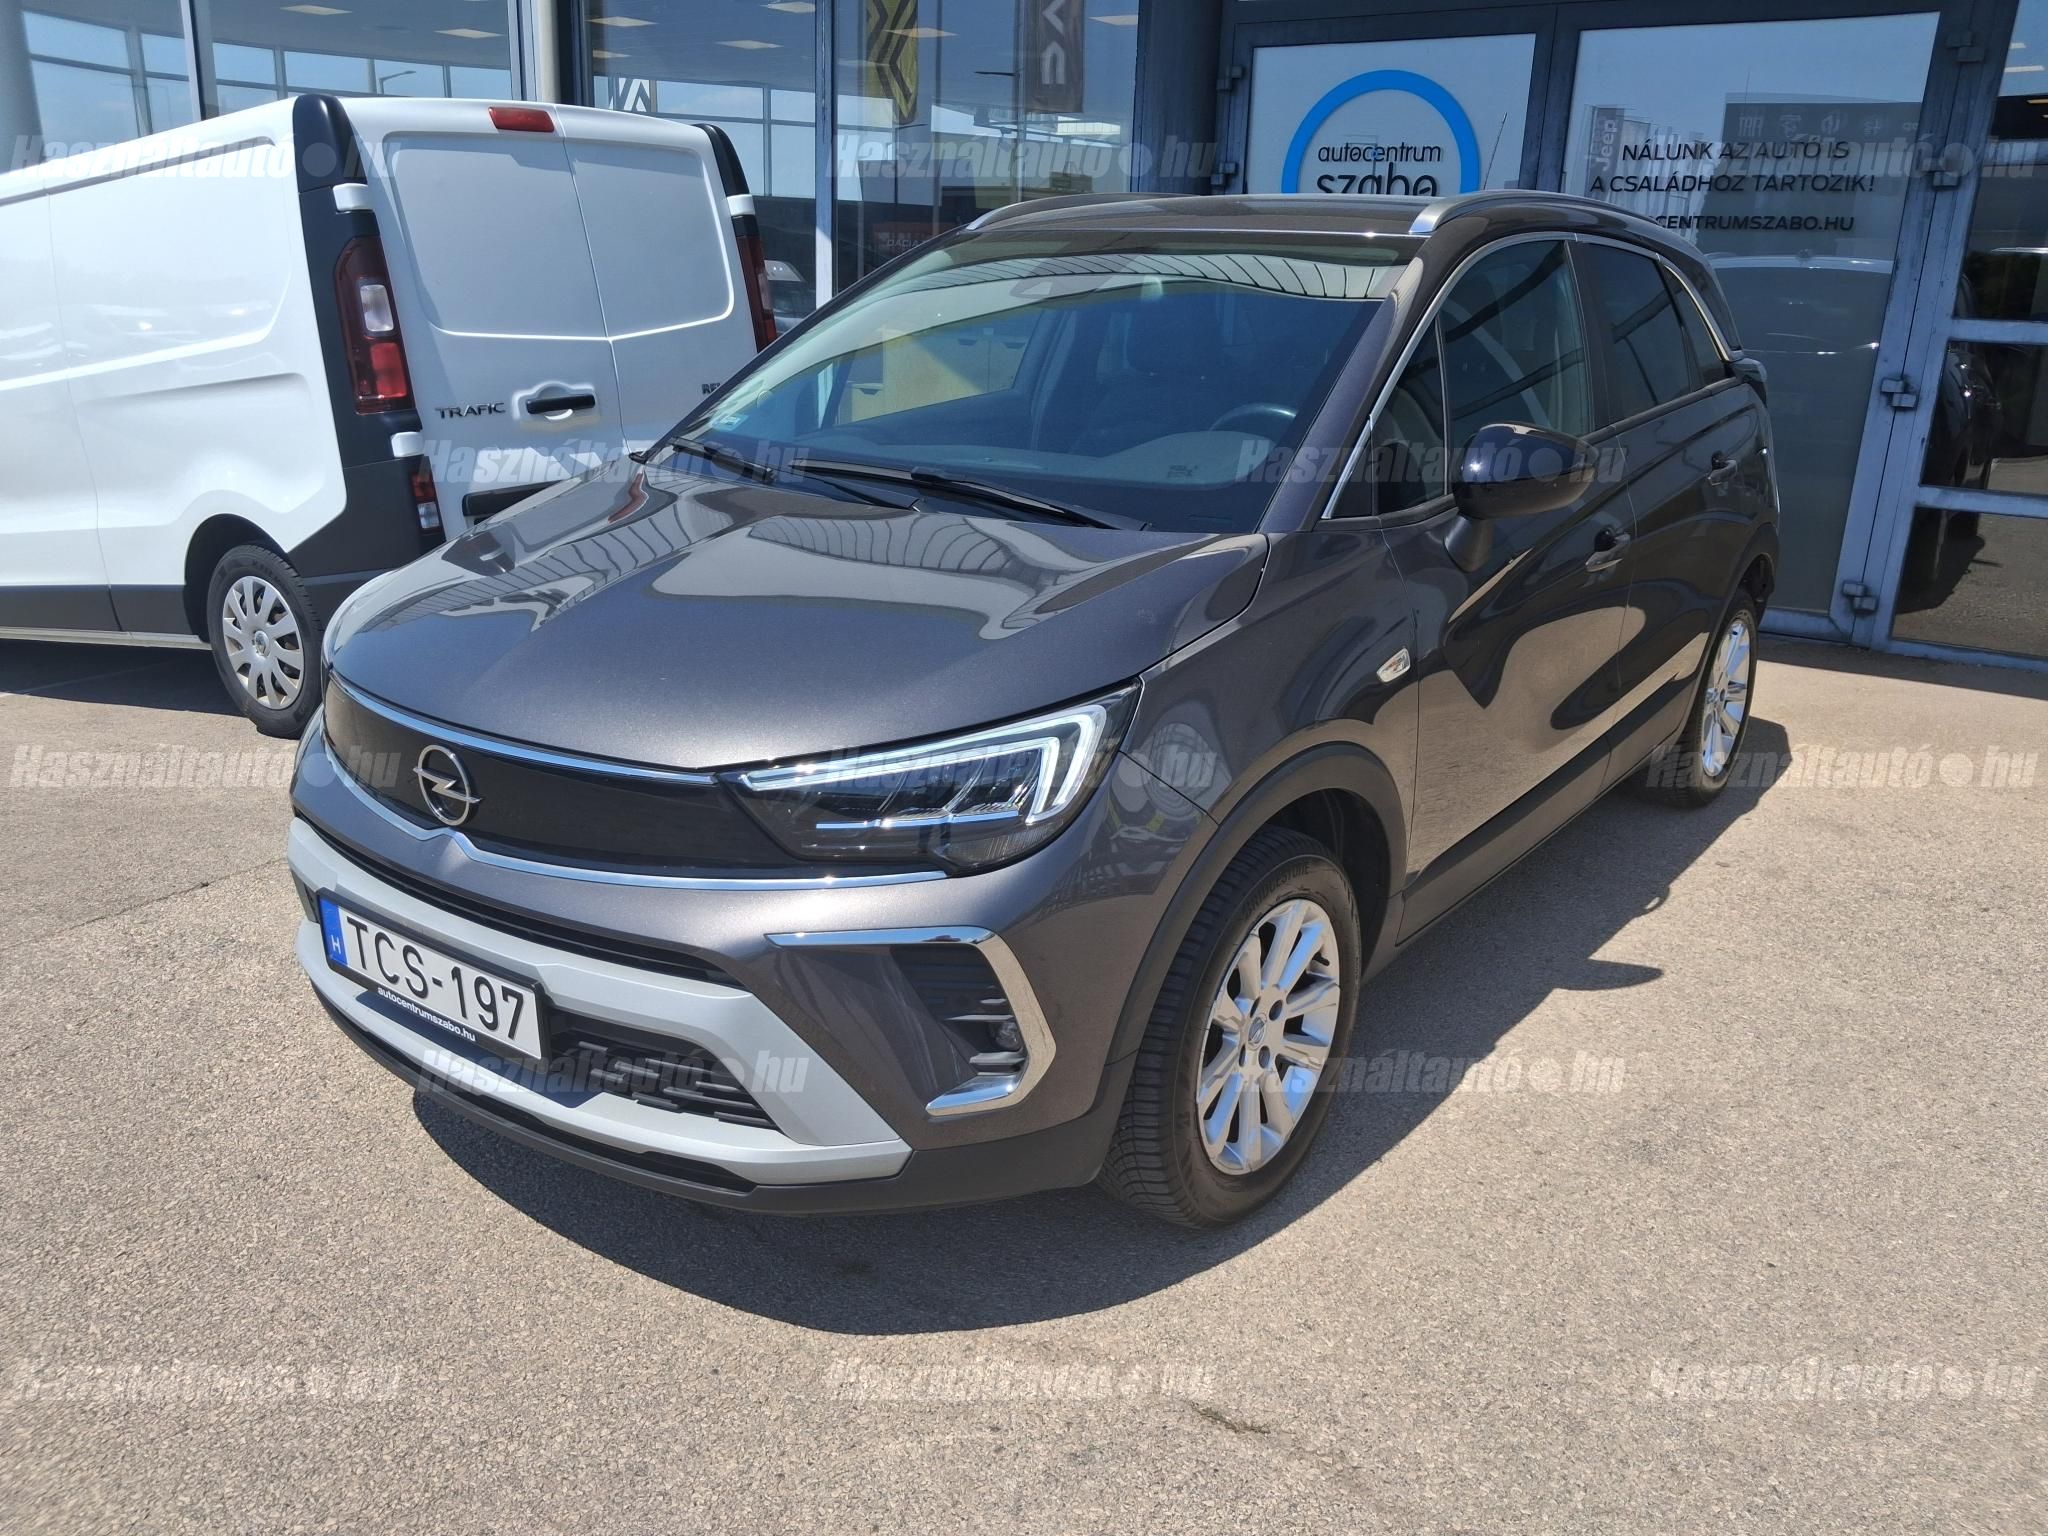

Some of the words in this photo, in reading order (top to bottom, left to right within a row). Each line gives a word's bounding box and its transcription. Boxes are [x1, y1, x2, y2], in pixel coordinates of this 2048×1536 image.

[1318, 142, 1442, 162] autocentrum
[1622, 139, 1714, 161] NÁLUNK
[1719, 142, 1749, 160] AZ
[1753, 138, 1822, 160] AUTÓ
[1826, 141, 1850, 159] IS
[1590, 176, 1605, 192] A
[1609, 171, 1746, 193] CSALÁDHOZ
[1752, 174, 1876, 192] TARTOZIK!
[435, 402, 507, 420] TRAFIC
[330, 934, 342, 954] H
[346, 915, 524, 1041] TCS-197
[377, 986, 477, 1043] autocentrumszabo.hu
